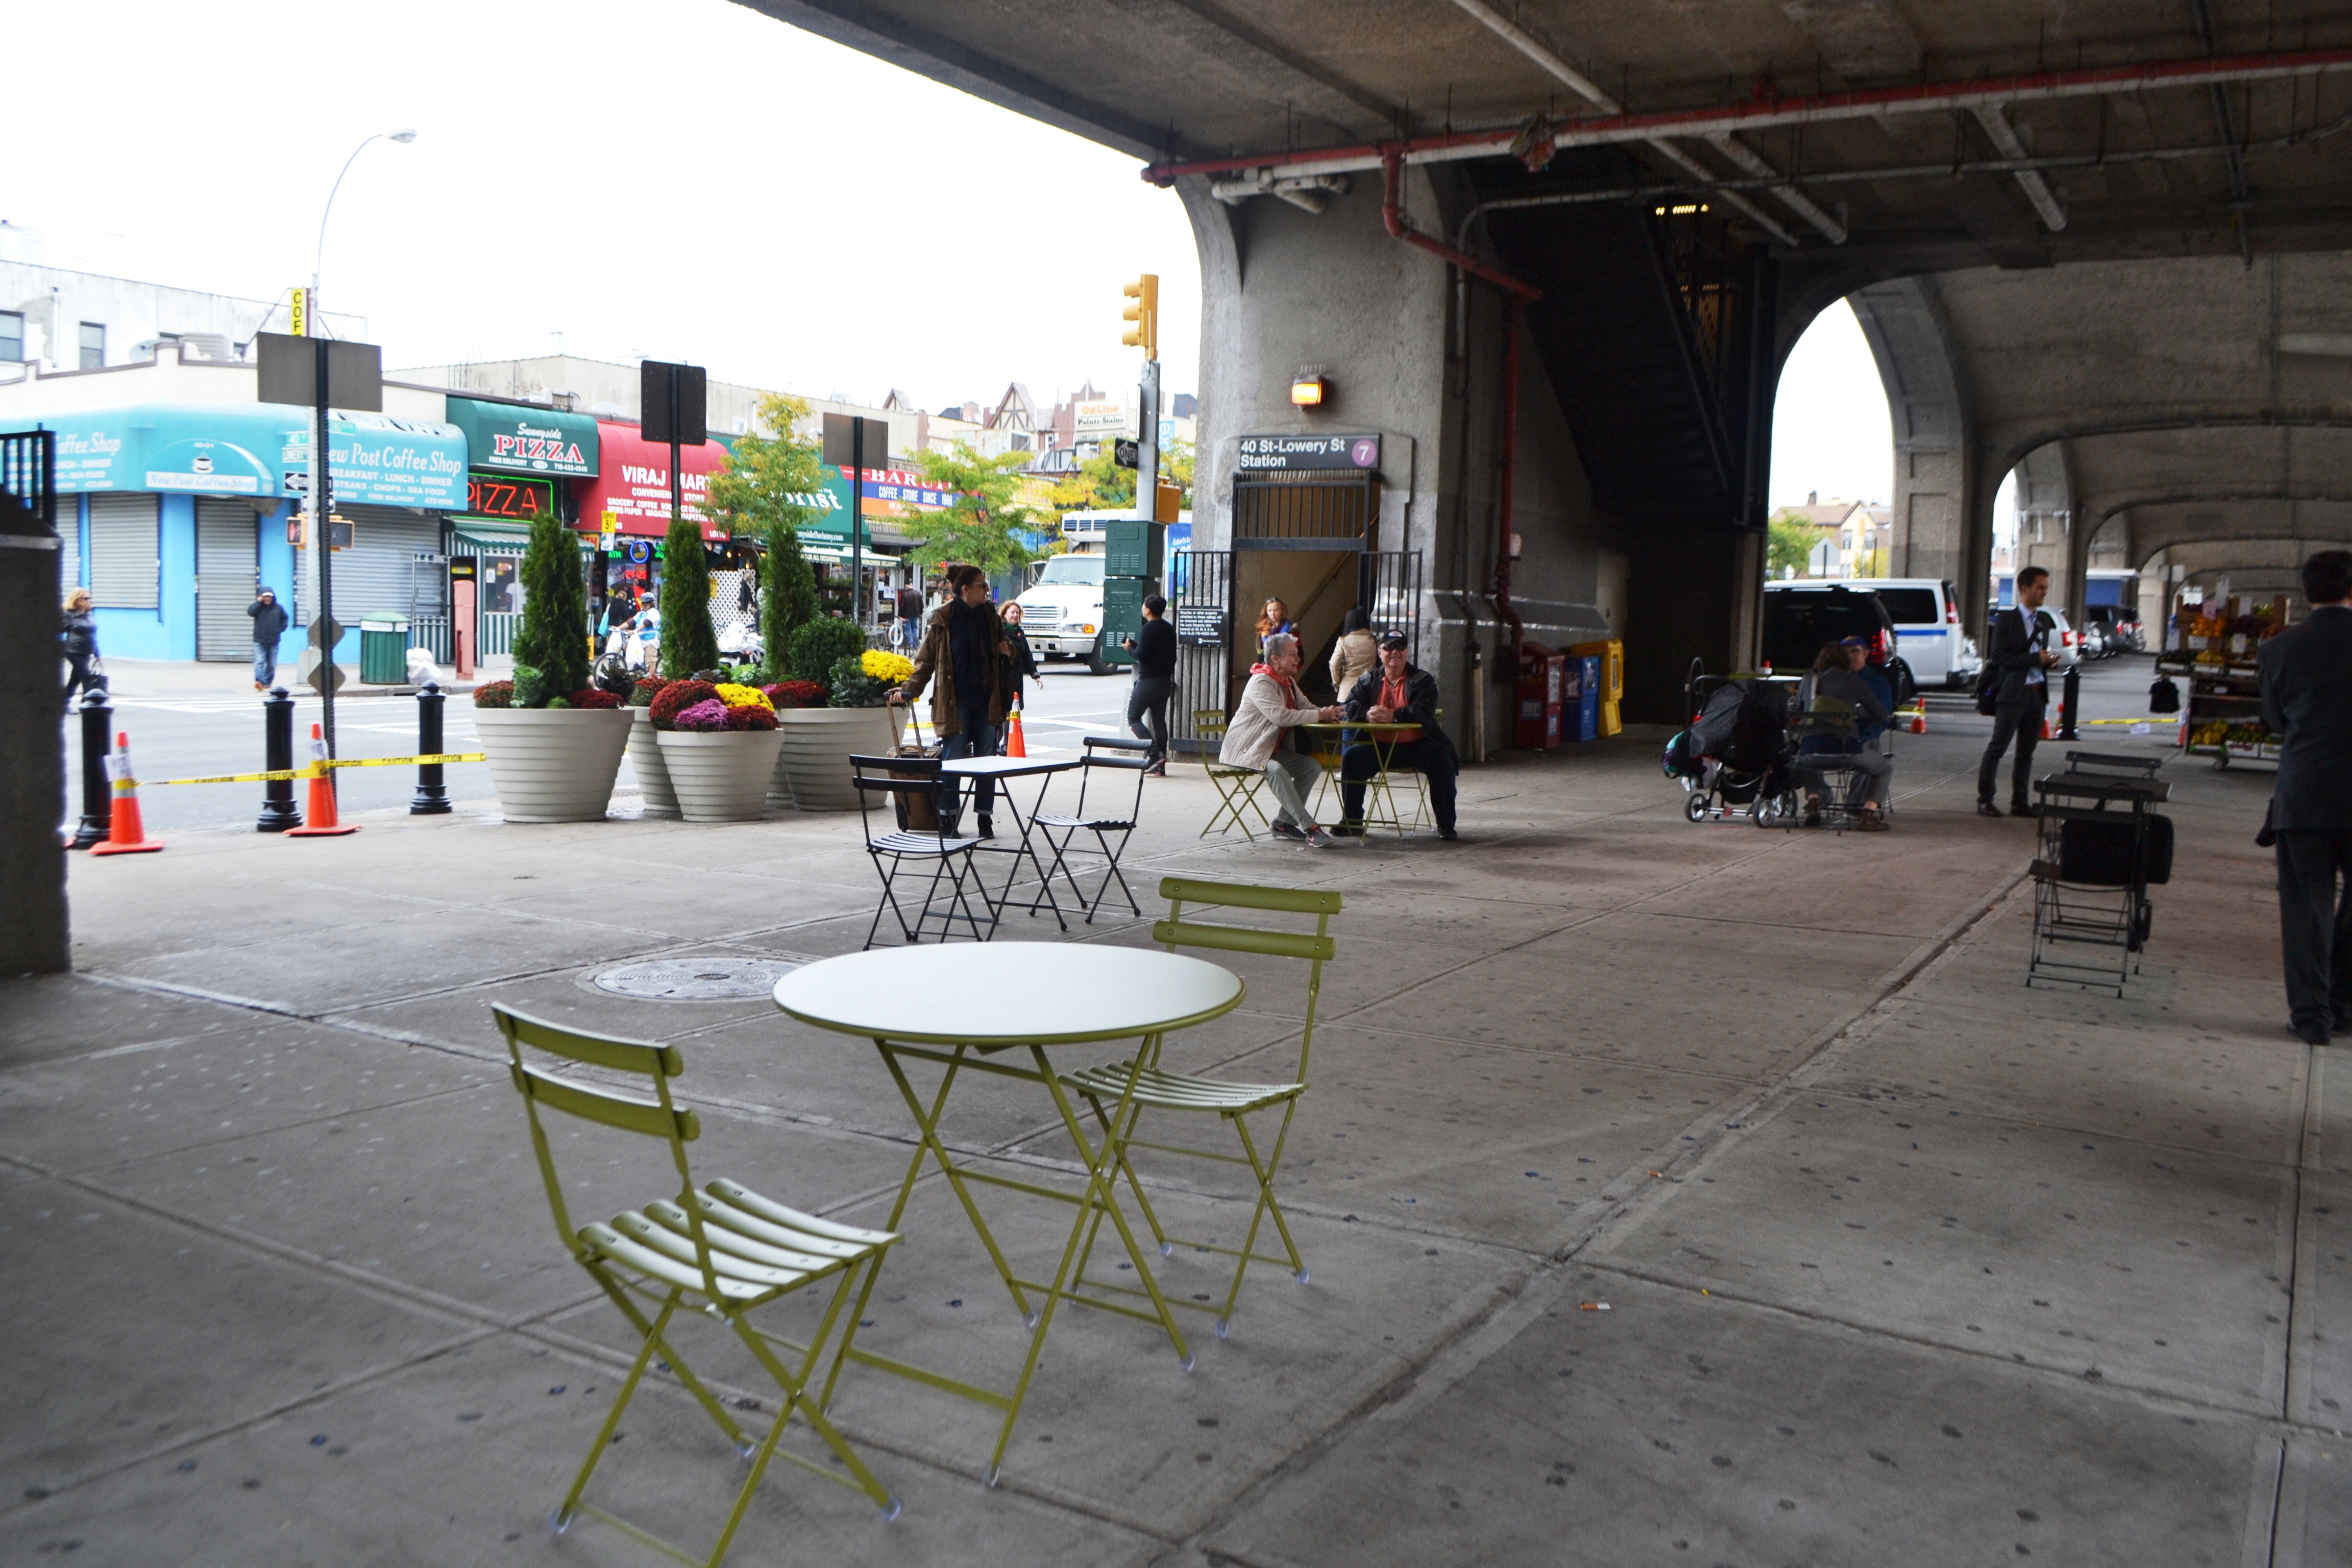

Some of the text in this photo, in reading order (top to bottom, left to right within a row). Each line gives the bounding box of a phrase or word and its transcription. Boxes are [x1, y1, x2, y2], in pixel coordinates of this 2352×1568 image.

[293, 292, 302, 335] COF
[517, 423, 561, 439] Sunnyside
[55, 432, 120, 456] offee Shop
[288, 434, 300, 444] 40
[494, 434, 584, 464] PIZZA
[1119, 448, 1135, 459] ONE
[1241, 438, 1369, 461] 40 St-Lowery St 7
[328, 443, 461, 477] ew Post Coffee Shop
[489, 456, 502, 464] FREE
[503, 457, 527, 467] DELIVERY
[1240, 454, 1286, 468] Station
[151, 474, 255, 489] New Post Coffee Shop
[290, 478, 306, 486] ONE
[385, 473, 414, 484] LUNCH
[421, 476, 452, 486] DINNER
[622, 465, 666, 486] VIRAJ
[333, 480, 367, 490] STEAKS
[373, 484, 402, 493] CHOPS
[407, 485, 423, 495] SEA
[425, 487, 446, 497] FOOD
[632, 487, 672, 499] CONVENIEN
[878, 485, 953, 506] COFFEE STORE SINCE 1966
[607, 498, 634, 506] GROCERY
[636, 500, 657, 509] COFFEE
[646, 510, 672, 518] MAGAZIN
[382, 757, 413, 766] CAUTION
[432, 754, 462, 763] CAUTION
[259, 772, 296, 780] CAUTION
